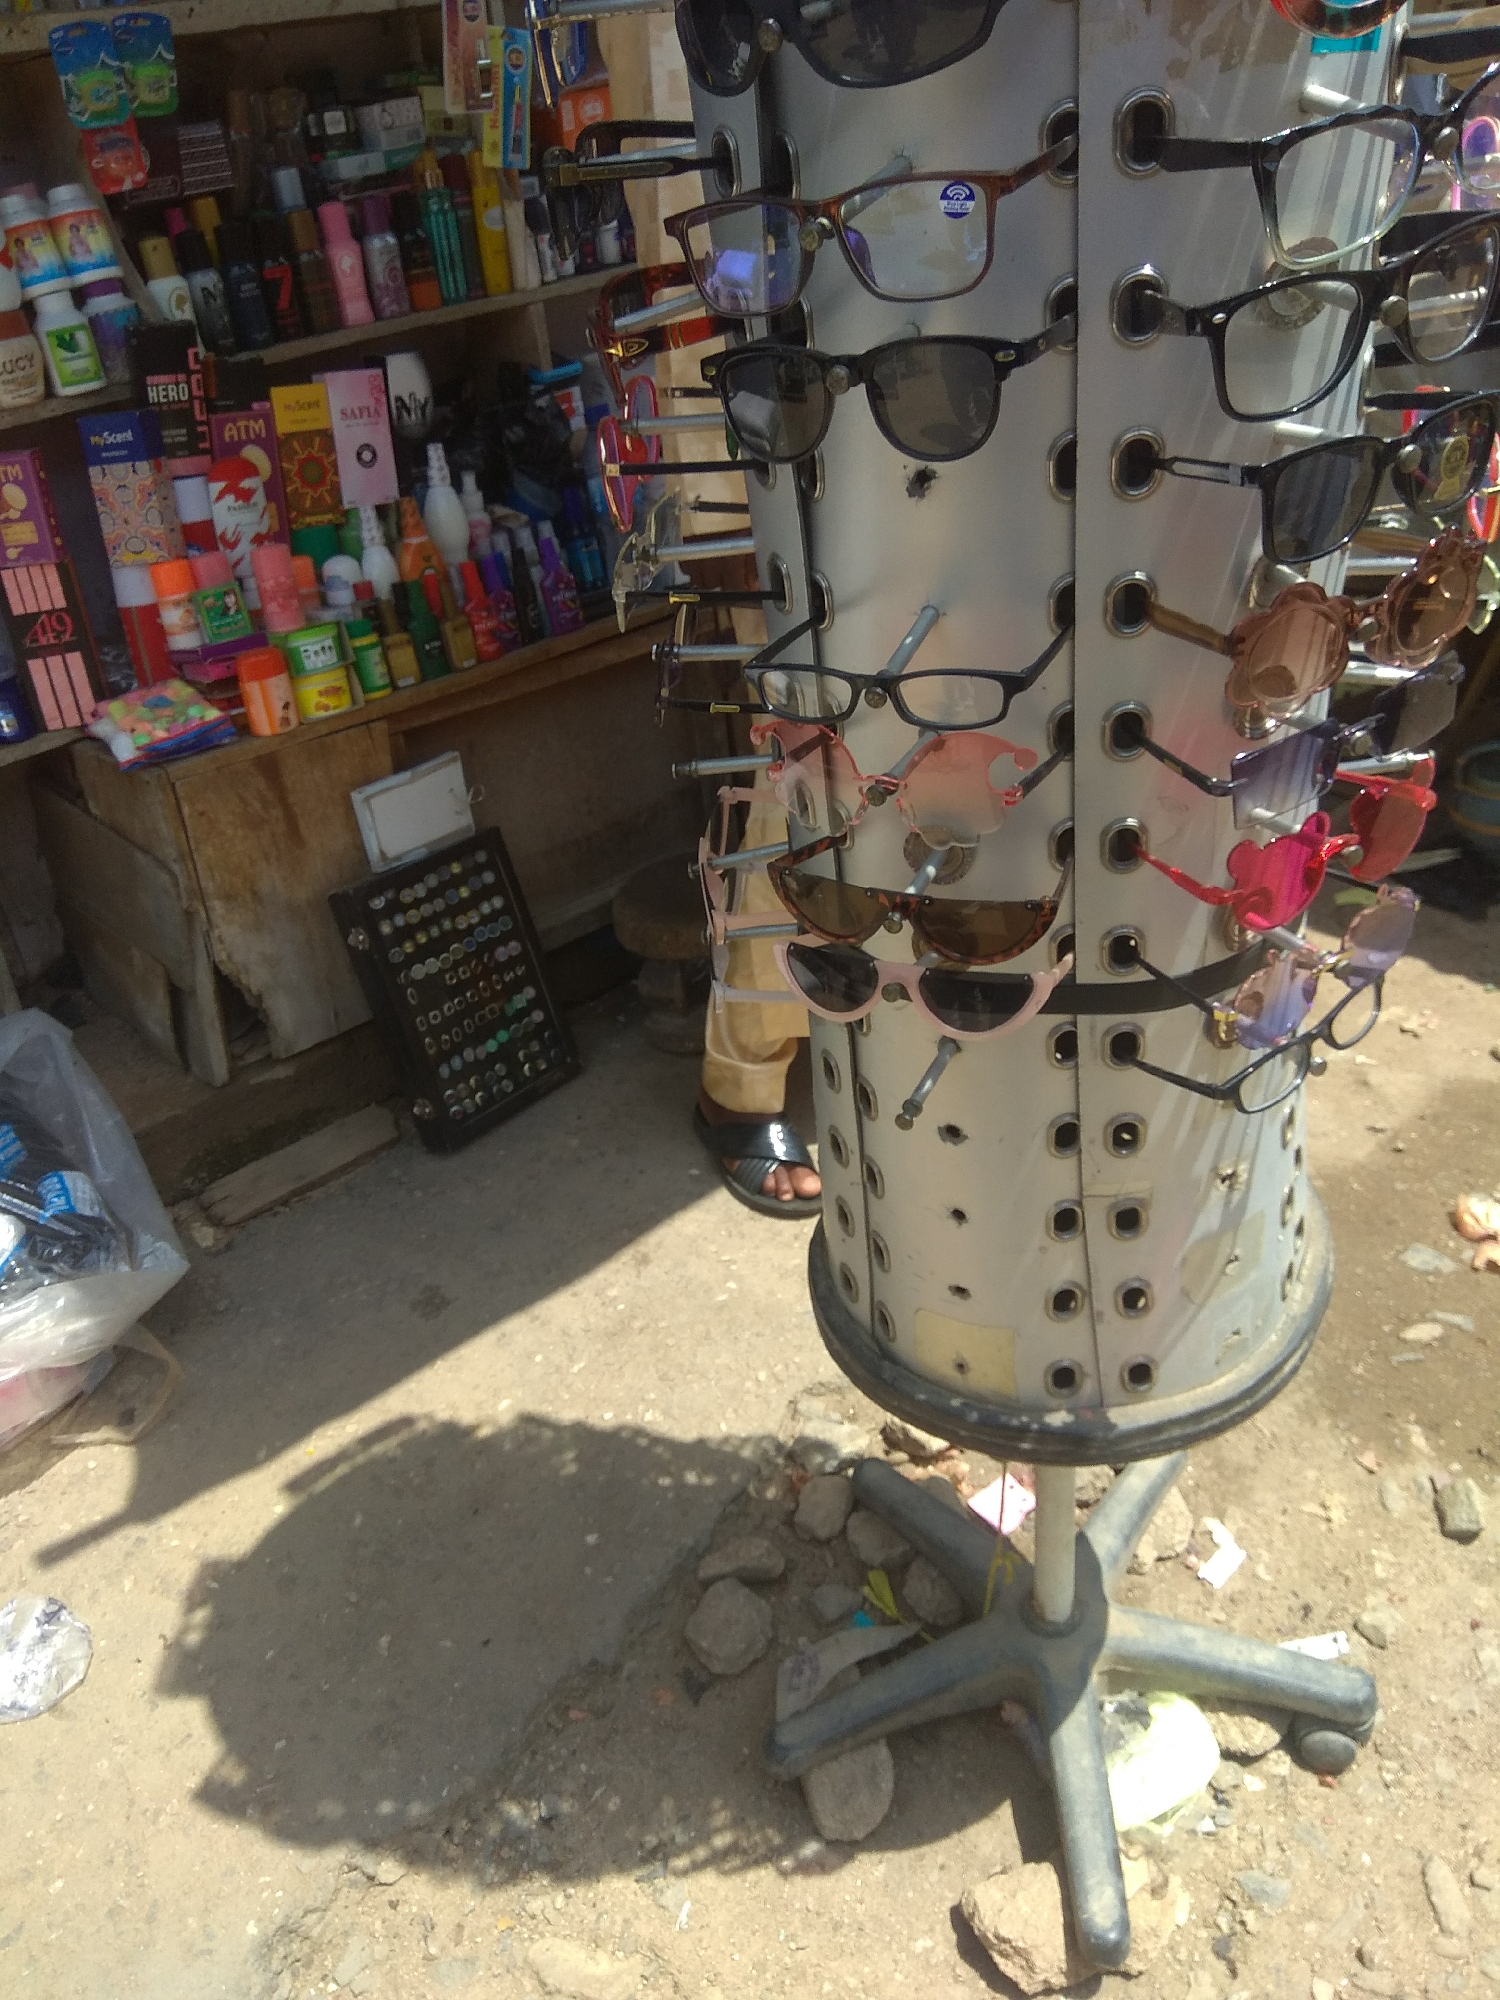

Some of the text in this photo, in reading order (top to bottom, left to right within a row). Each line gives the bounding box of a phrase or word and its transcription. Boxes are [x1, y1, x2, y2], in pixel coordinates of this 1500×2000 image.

[262, 264, 292, 313] 7
[0, 352, 35, 376] UCY
[147, 383, 189, 404] HERO
[223, 418, 267, 443] ATM
[0, 463, 24, 483] TM
